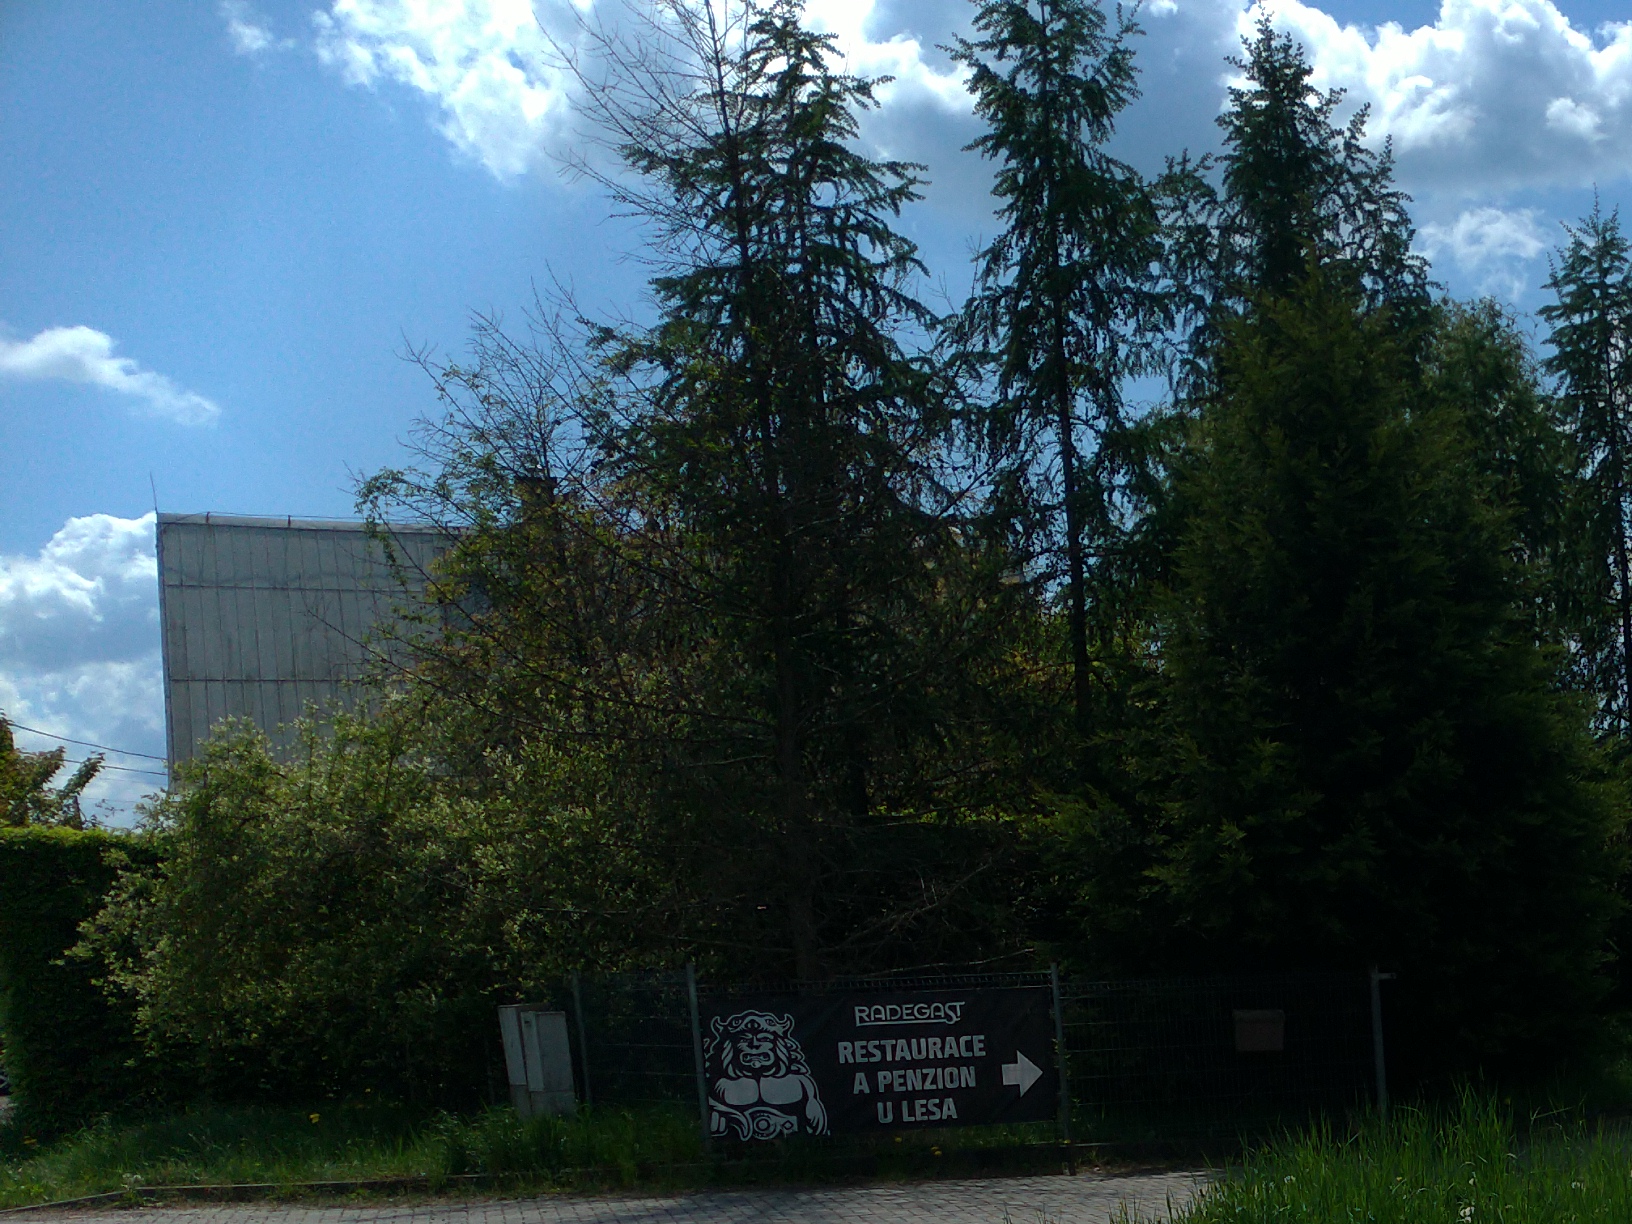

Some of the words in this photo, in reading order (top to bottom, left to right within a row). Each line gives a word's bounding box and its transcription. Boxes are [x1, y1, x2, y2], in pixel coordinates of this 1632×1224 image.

[854, 1001, 966, 1027] RADEGAST
[838, 1034, 986, 1065] RESTAURACE
[852, 1072, 870, 1095] A
[878, 1065, 976, 1094] PENZION
[877, 1101, 893, 1124] U
[902, 1097, 957, 1122] LESA
